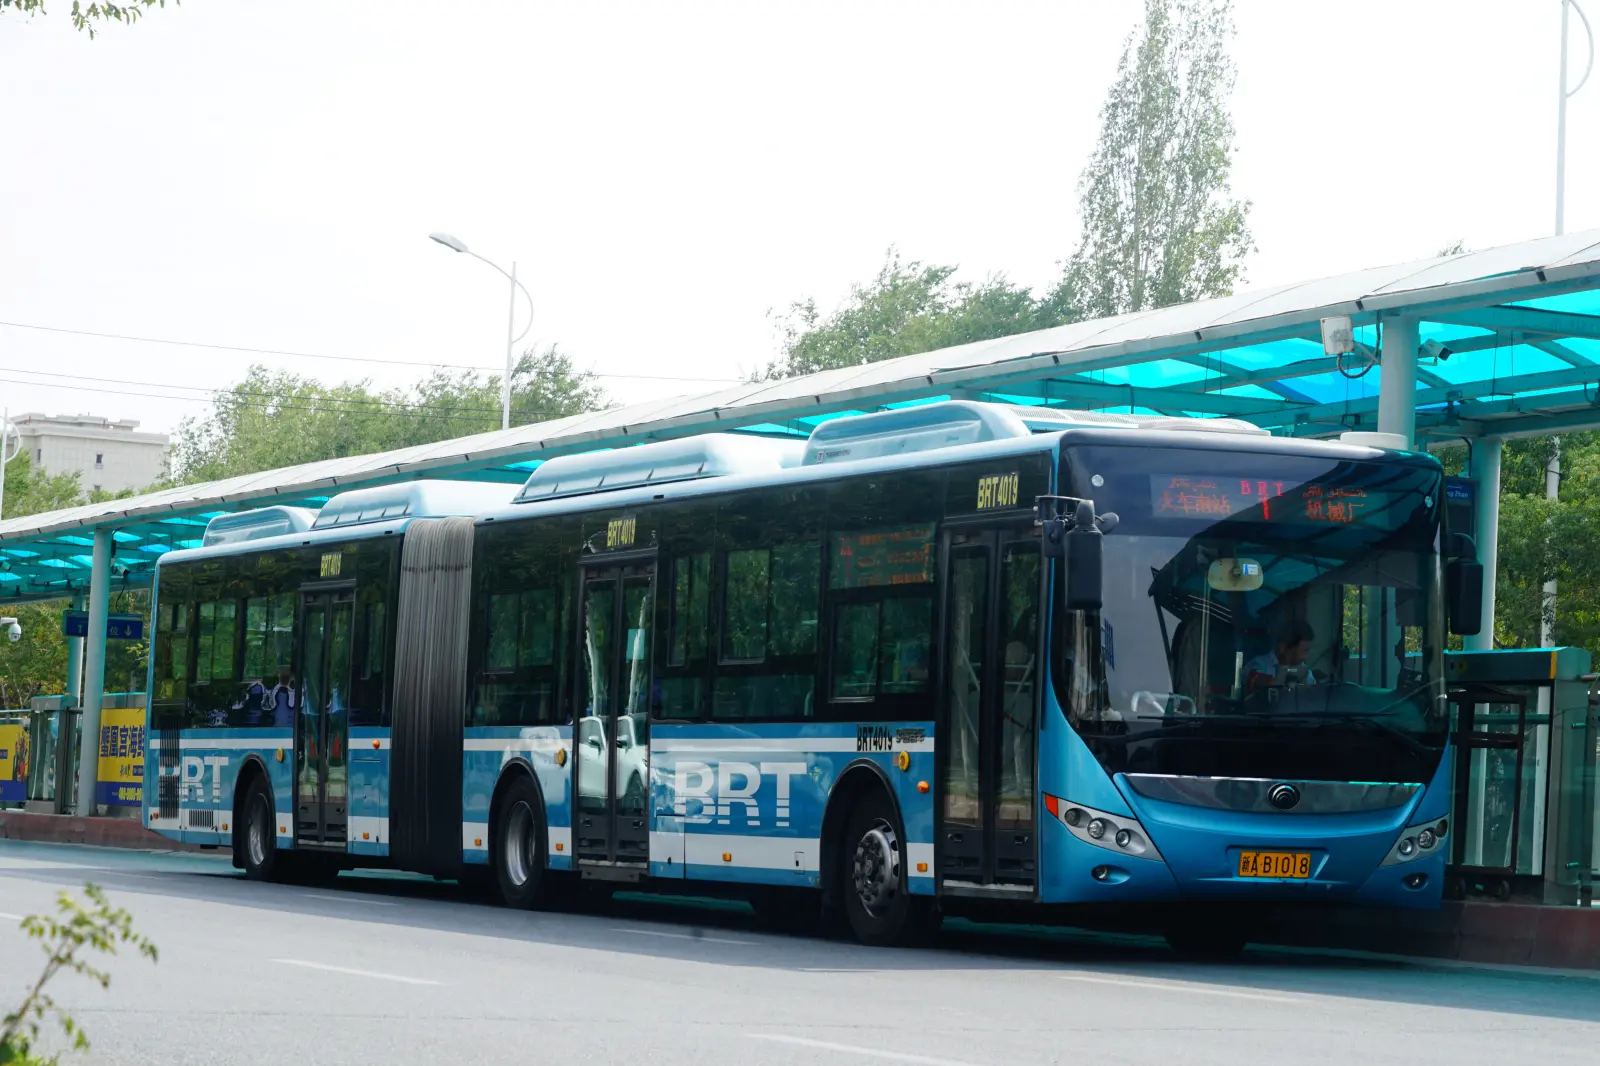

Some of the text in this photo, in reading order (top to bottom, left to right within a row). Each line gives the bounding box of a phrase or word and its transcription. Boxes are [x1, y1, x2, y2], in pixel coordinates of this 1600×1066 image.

[977, 474, 1018, 509] BRT4019
[1158, 490, 1231, 514] 火车南站
[1306, 500, 1364, 522] 机械厂
[857, 726, 892, 751] BRT4019
[674, 761, 807, 827] BRT
